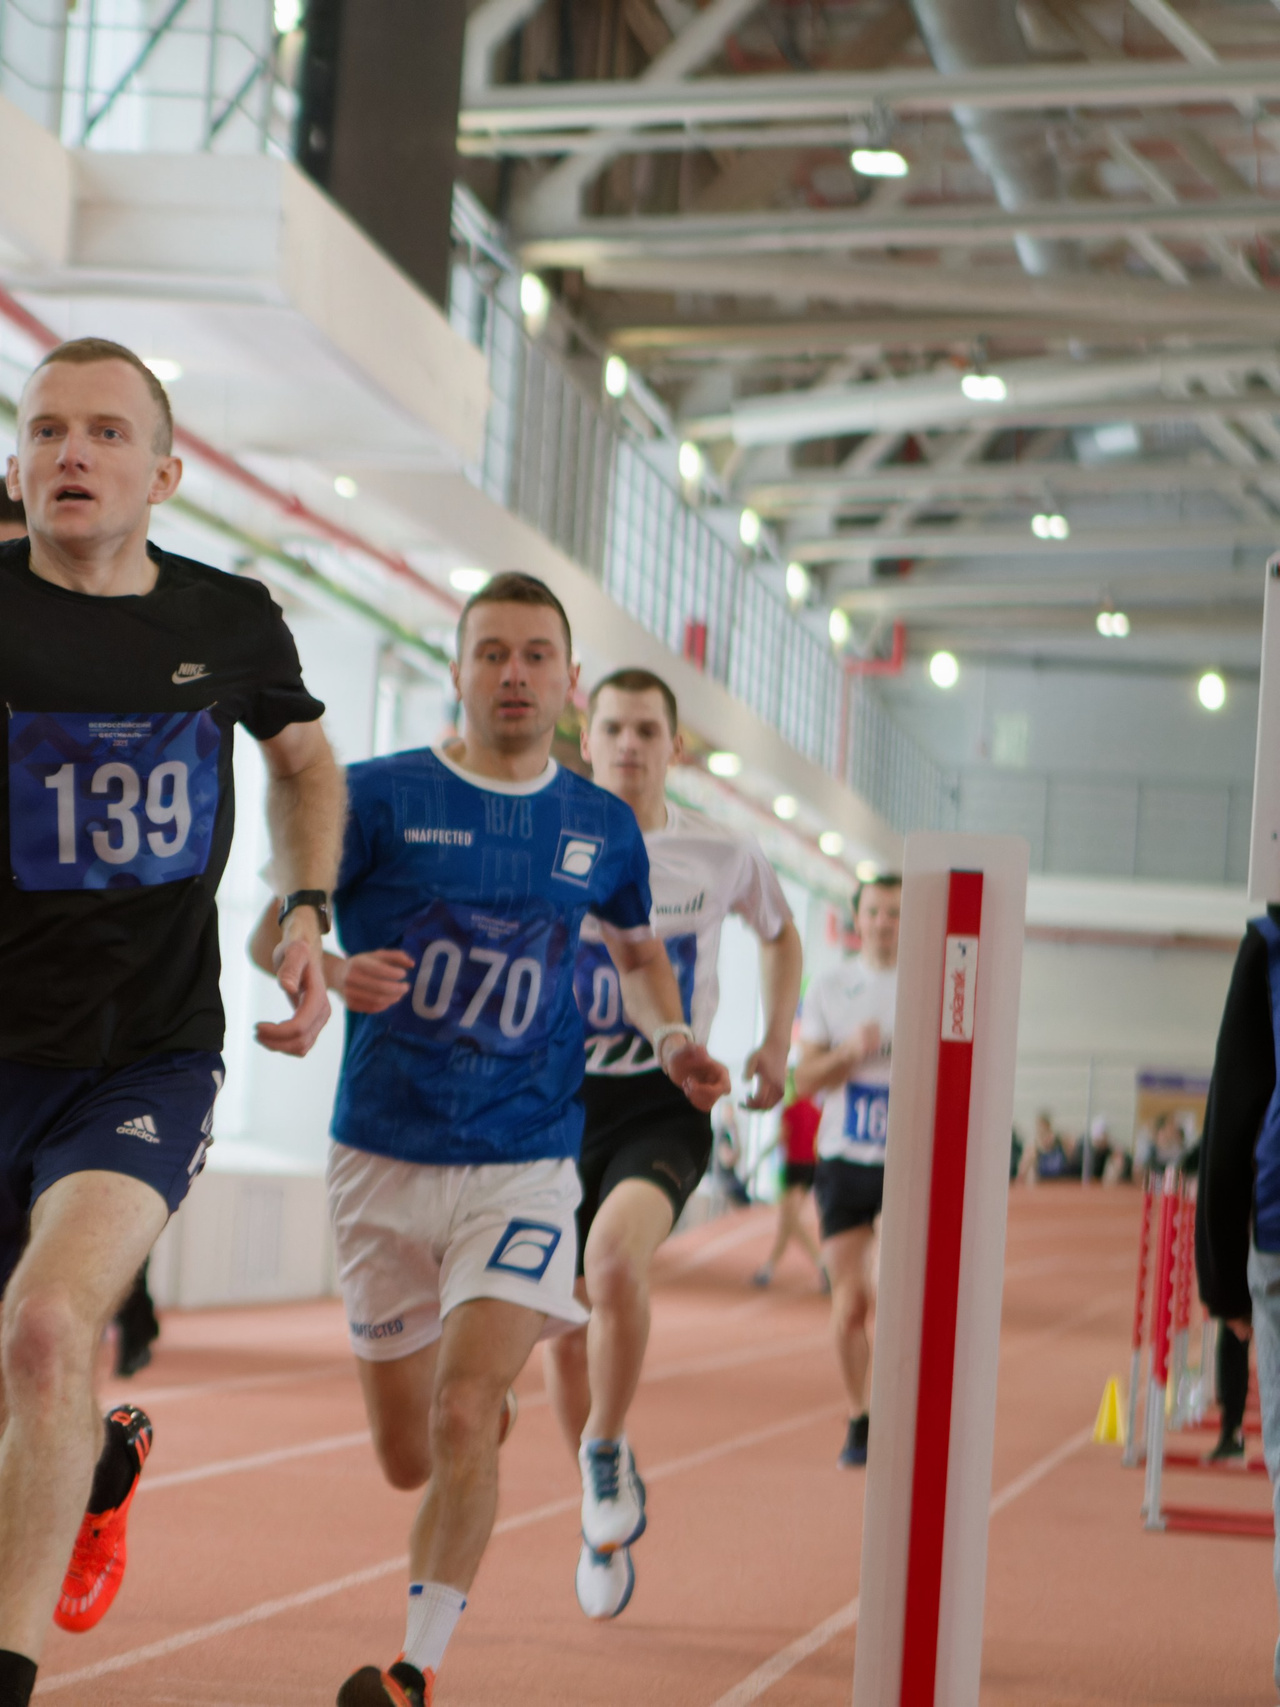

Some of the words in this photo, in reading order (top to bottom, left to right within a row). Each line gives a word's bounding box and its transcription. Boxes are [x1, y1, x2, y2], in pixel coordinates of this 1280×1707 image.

[178, 662, 206, 675] NIKE
[45, 761, 192, 864] 139
[404, 828, 472, 847] UNAFFECTED
[411, 939, 542, 1039] 070
